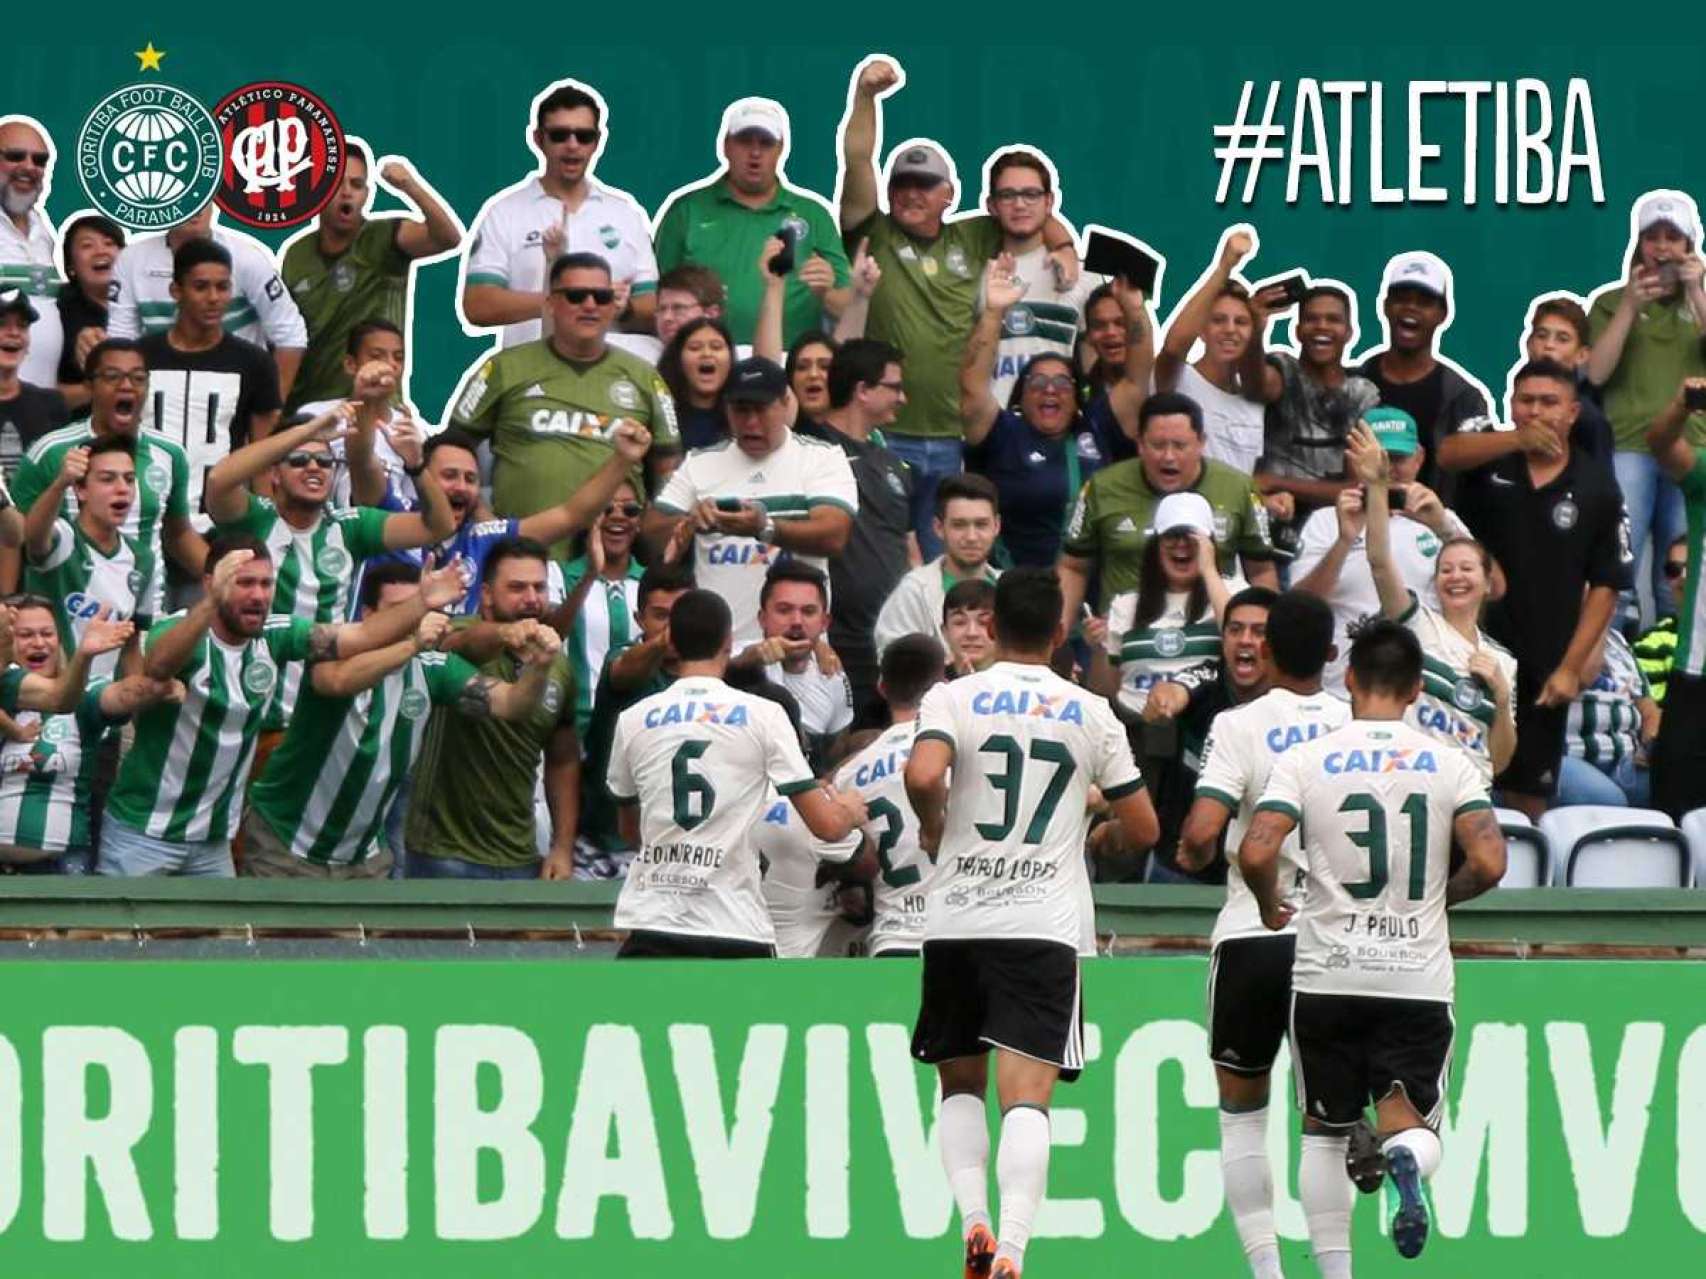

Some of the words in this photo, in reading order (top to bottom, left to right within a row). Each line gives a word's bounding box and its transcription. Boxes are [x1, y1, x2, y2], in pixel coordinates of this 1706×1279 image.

[644, 701, 749, 729] CAIXA
[971, 690, 1084, 726] CAIXA
[1266, 723, 1319, 753] CAI
[856, 749, 911, 787] CAI
[1323, 749, 1438, 774] CAIXA
[671, 740, 716, 831] 6
[973, 734, 1078, 845] 37
[1336, 792, 1427, 901] 31
[1367, 913, 1419, 939] PAULO
